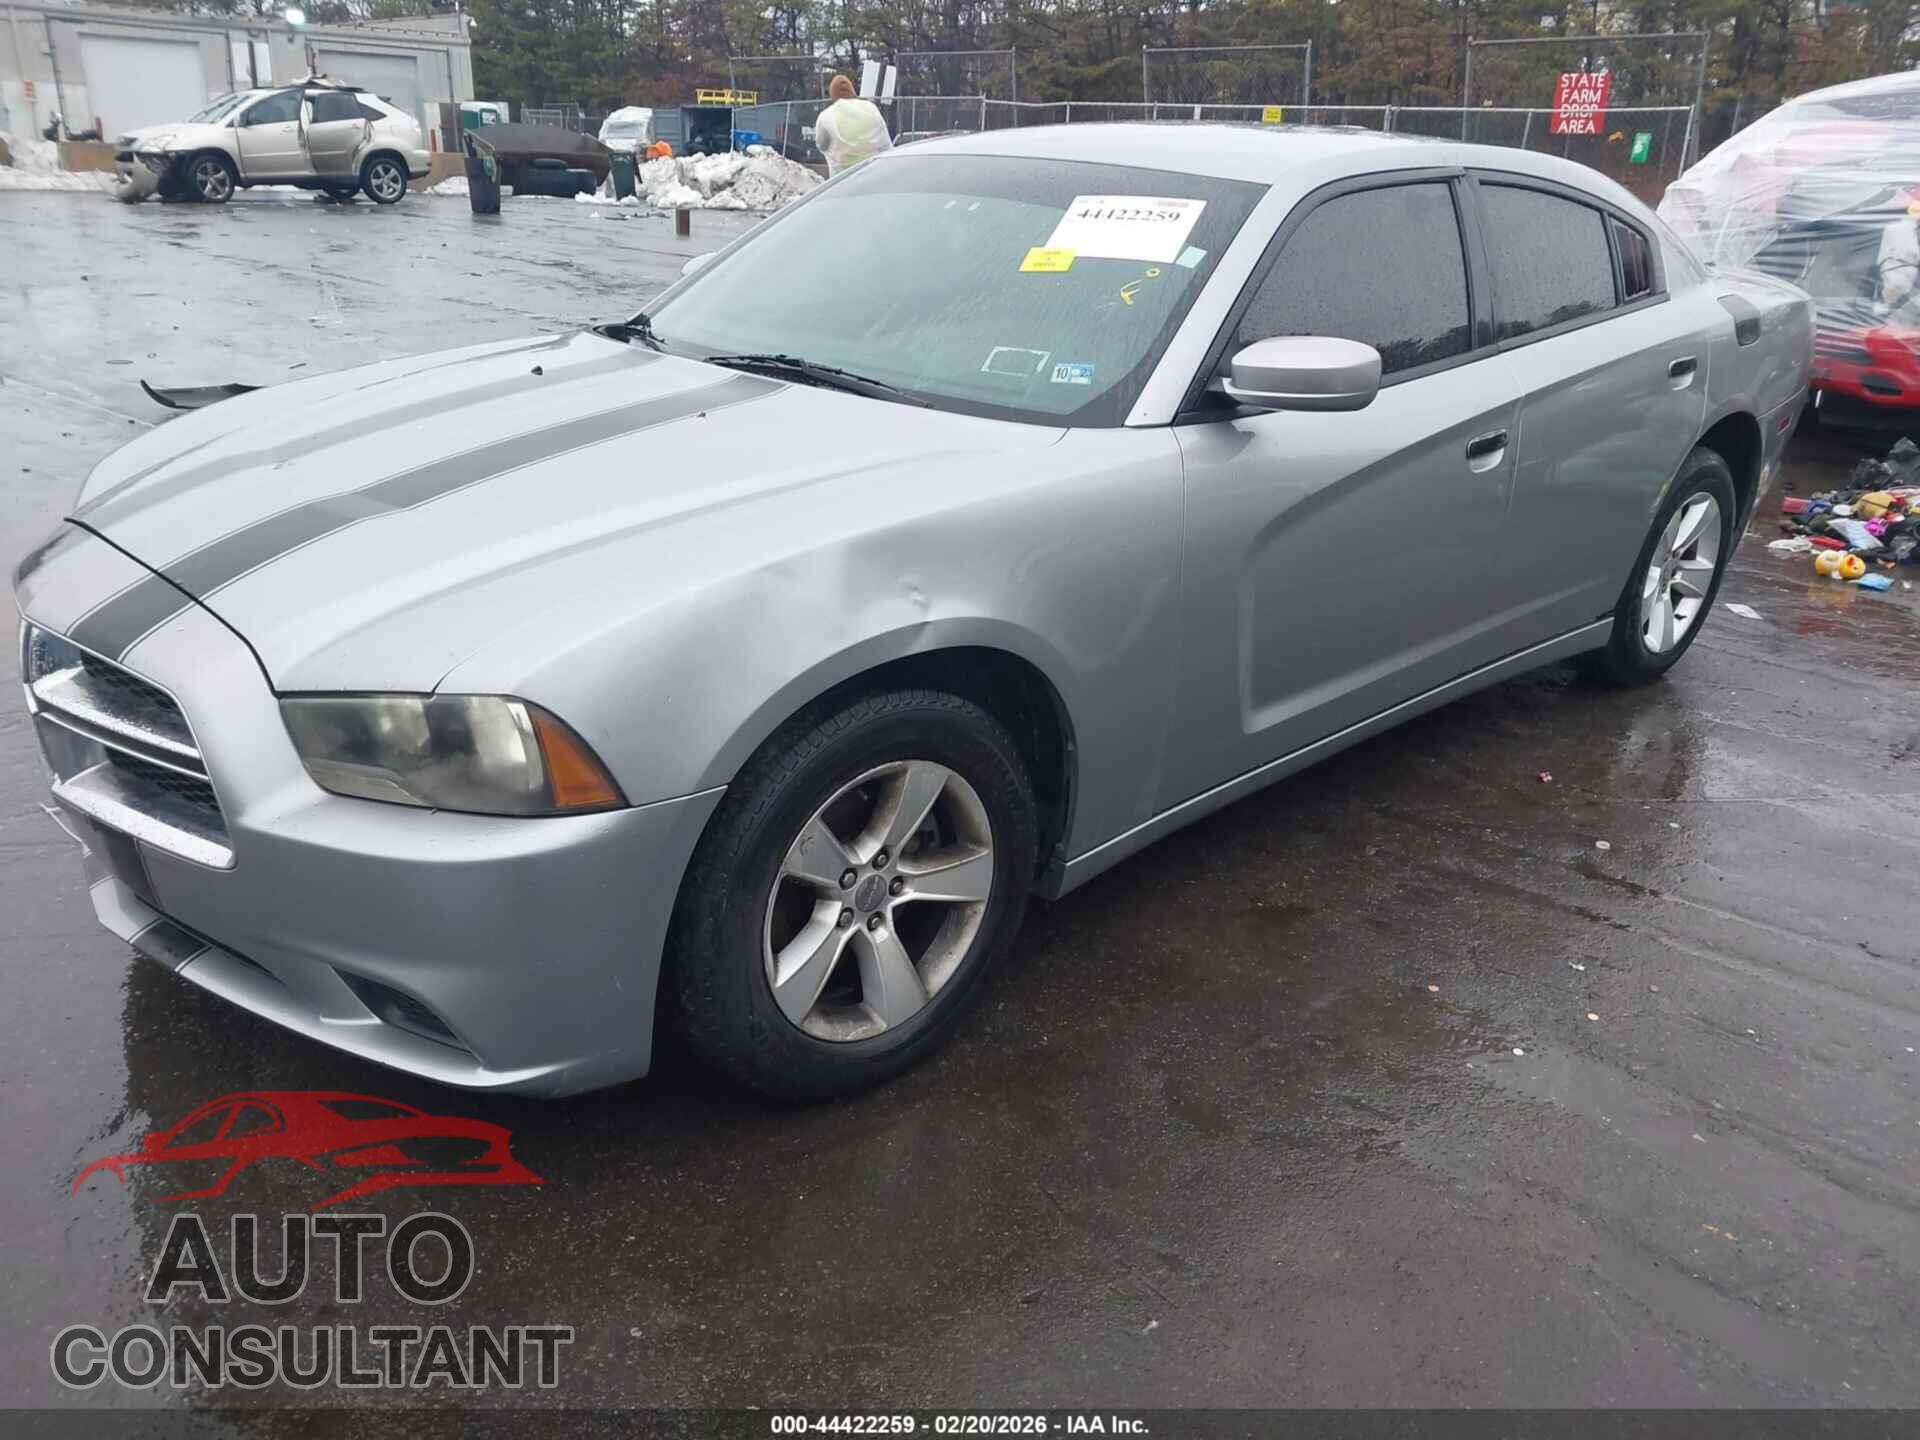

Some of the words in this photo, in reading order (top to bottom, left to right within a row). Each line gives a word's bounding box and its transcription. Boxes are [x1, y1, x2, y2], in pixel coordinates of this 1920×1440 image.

[1560, 73, 1605, 88] STATE
[1561, 88, 1600, 103] FARM
[1560, 103, 1599, 118] DROP
[1557, 119, 1596, 134] AREA
